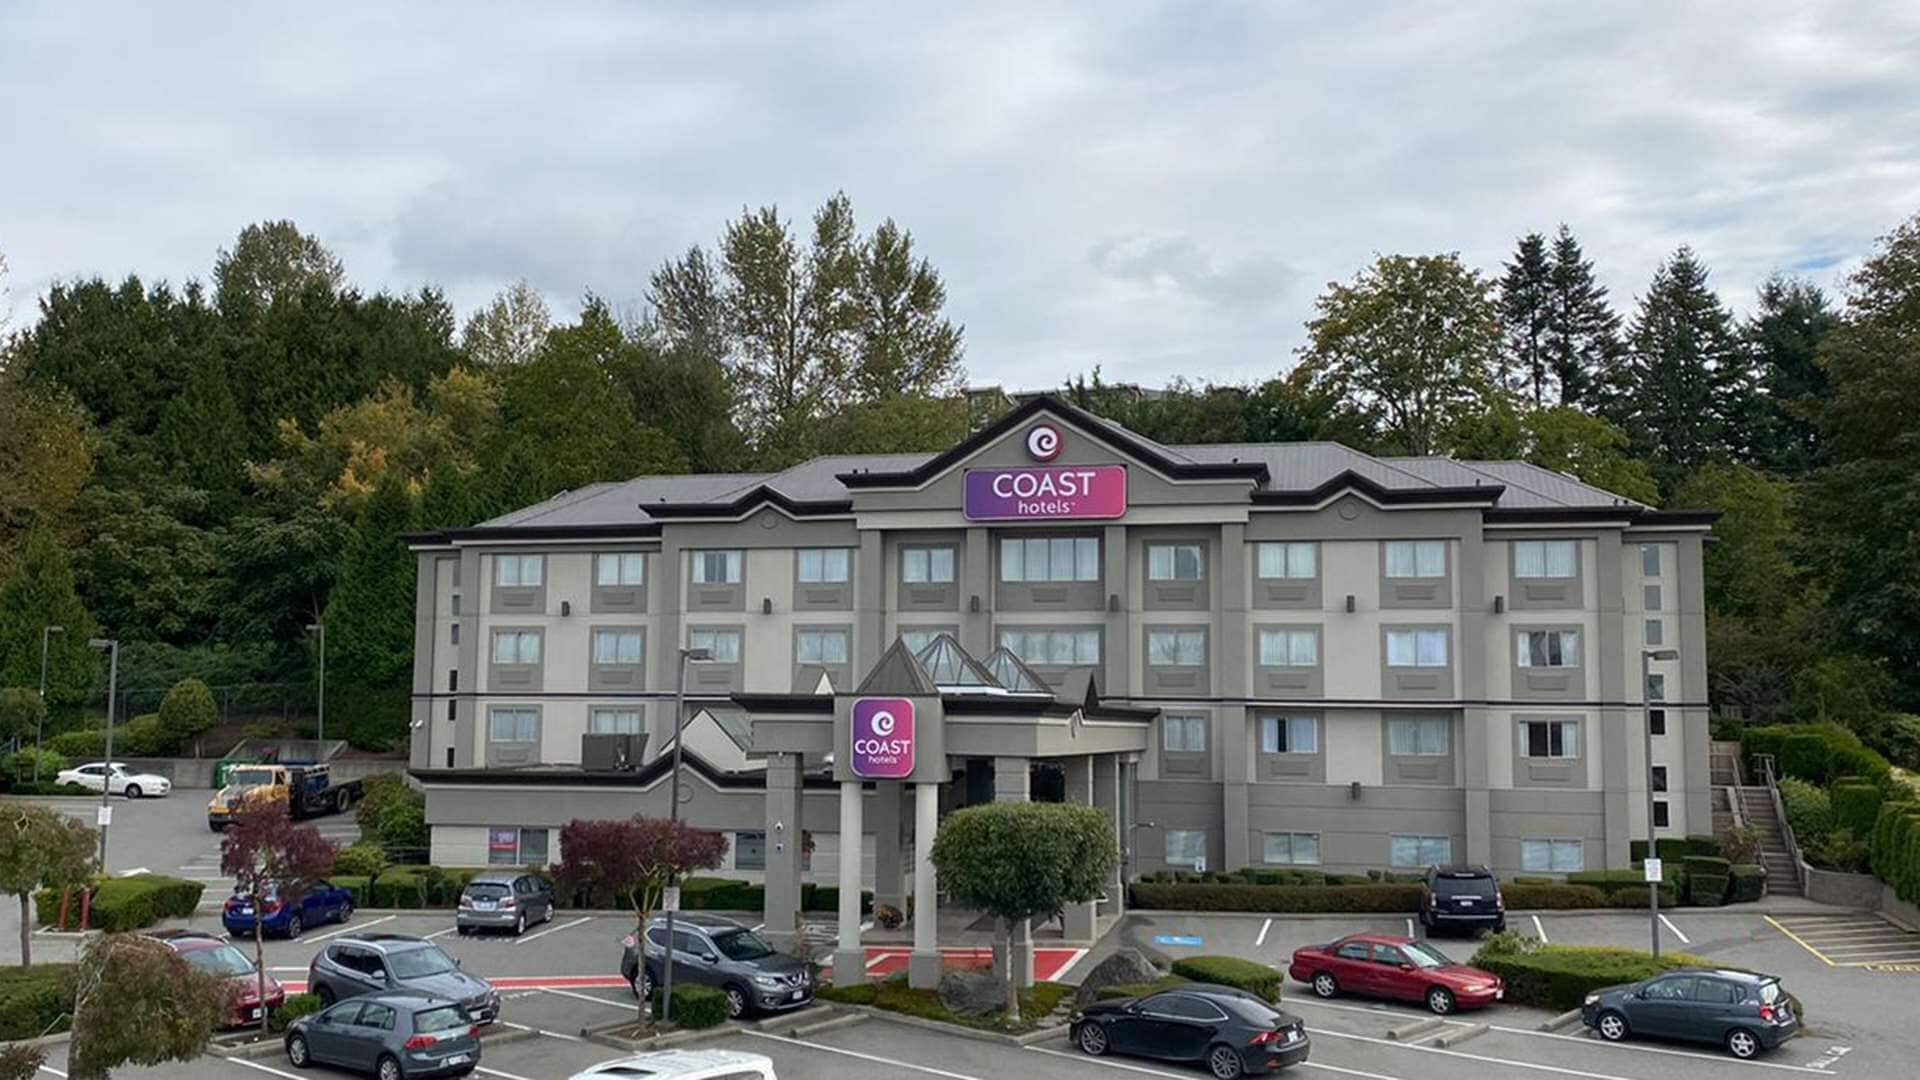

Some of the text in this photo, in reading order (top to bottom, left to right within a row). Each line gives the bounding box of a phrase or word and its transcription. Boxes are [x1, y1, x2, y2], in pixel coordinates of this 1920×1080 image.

[993, 472, 1095, 497] COAST
[1018, 501, 1071, 515] hotels
[855, 740, 911, 754] COAST
